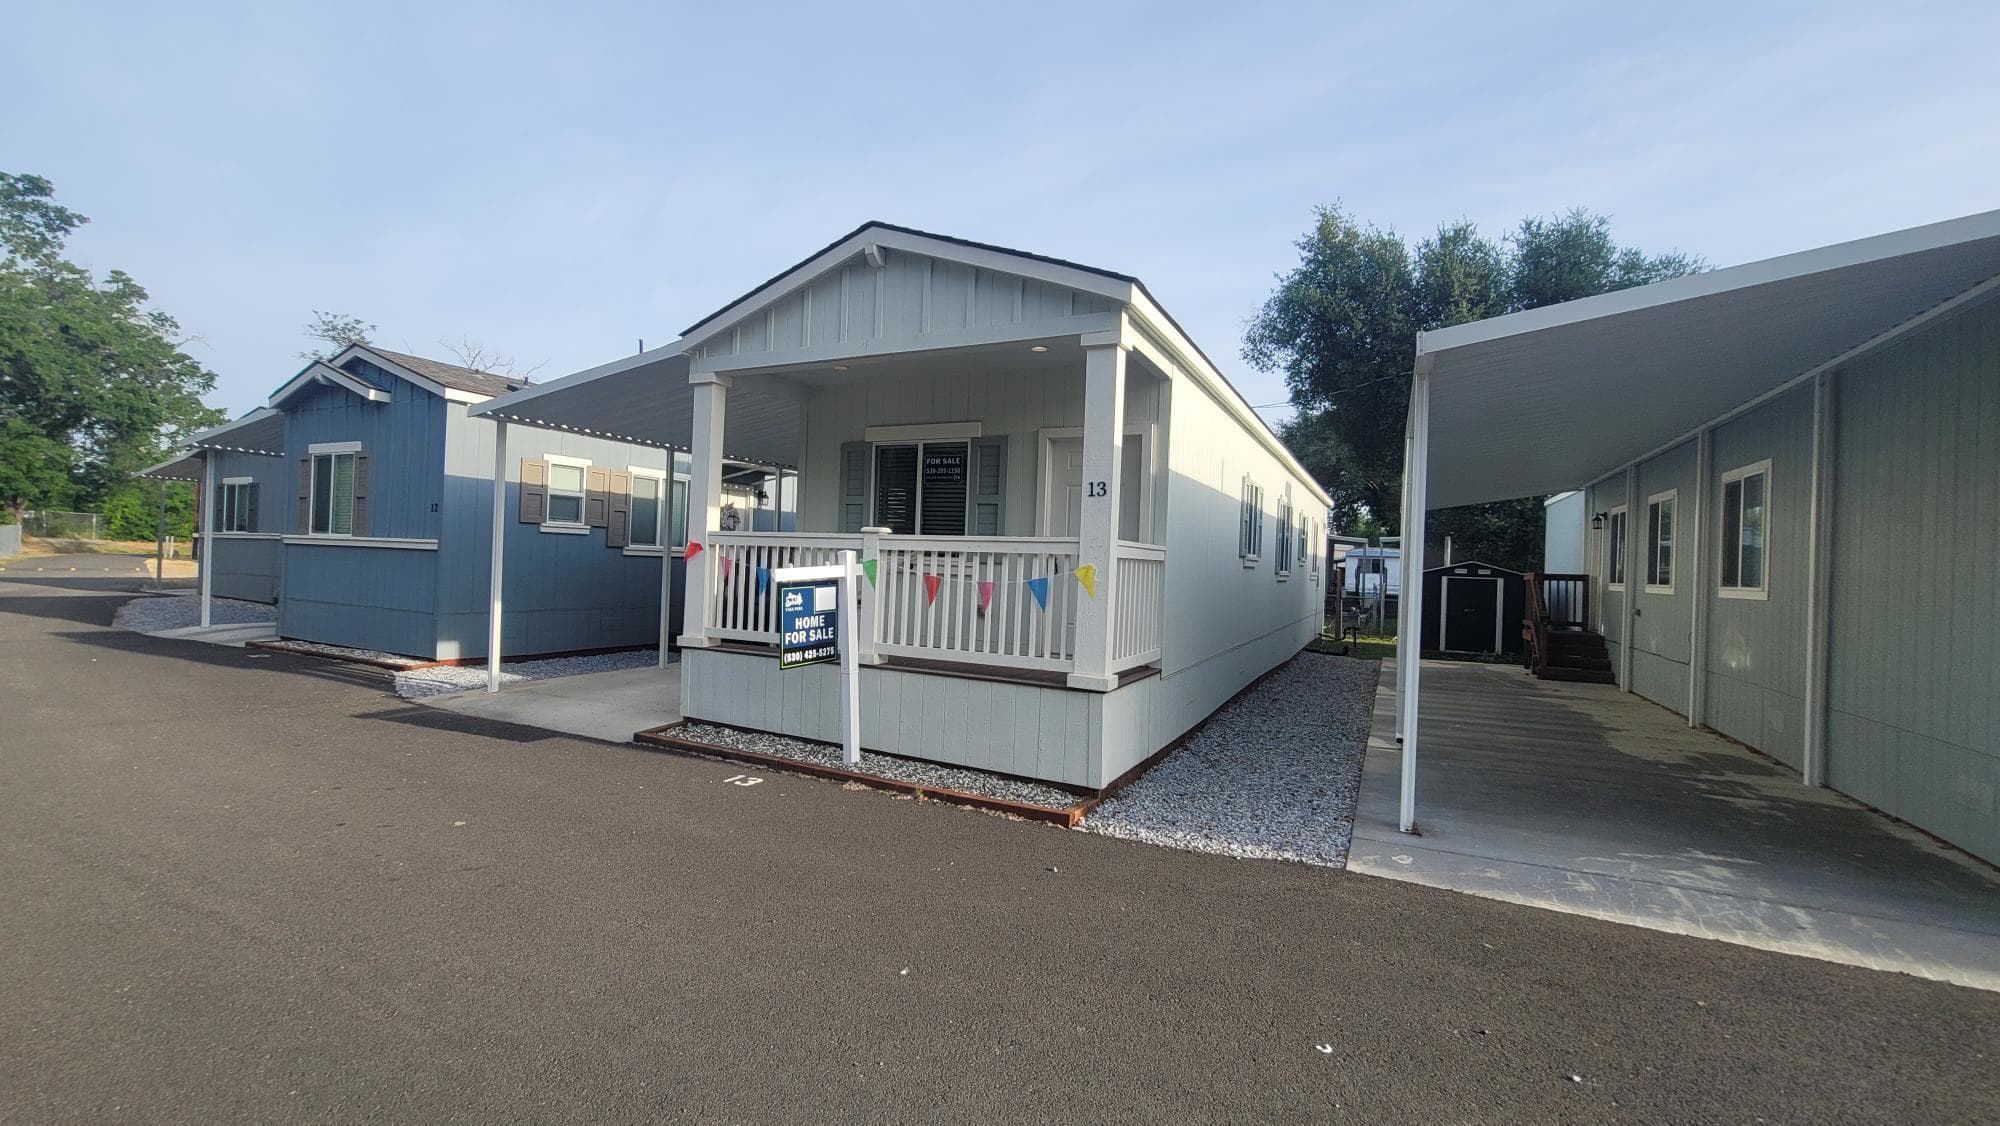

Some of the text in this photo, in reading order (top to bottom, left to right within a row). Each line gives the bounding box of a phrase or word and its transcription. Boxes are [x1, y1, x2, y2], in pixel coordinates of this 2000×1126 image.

[926, 457, 941, 465] FOR
[1087, 481, 1107, 497] 13
[431, 503, 439, 513] 12
[795, 615, 825, 630] HOME
[785, 627, 834, 645] FOR SALE
[784, 646, 835, 664] (530) 425-5275
[722, 774, 764, 787] 13
